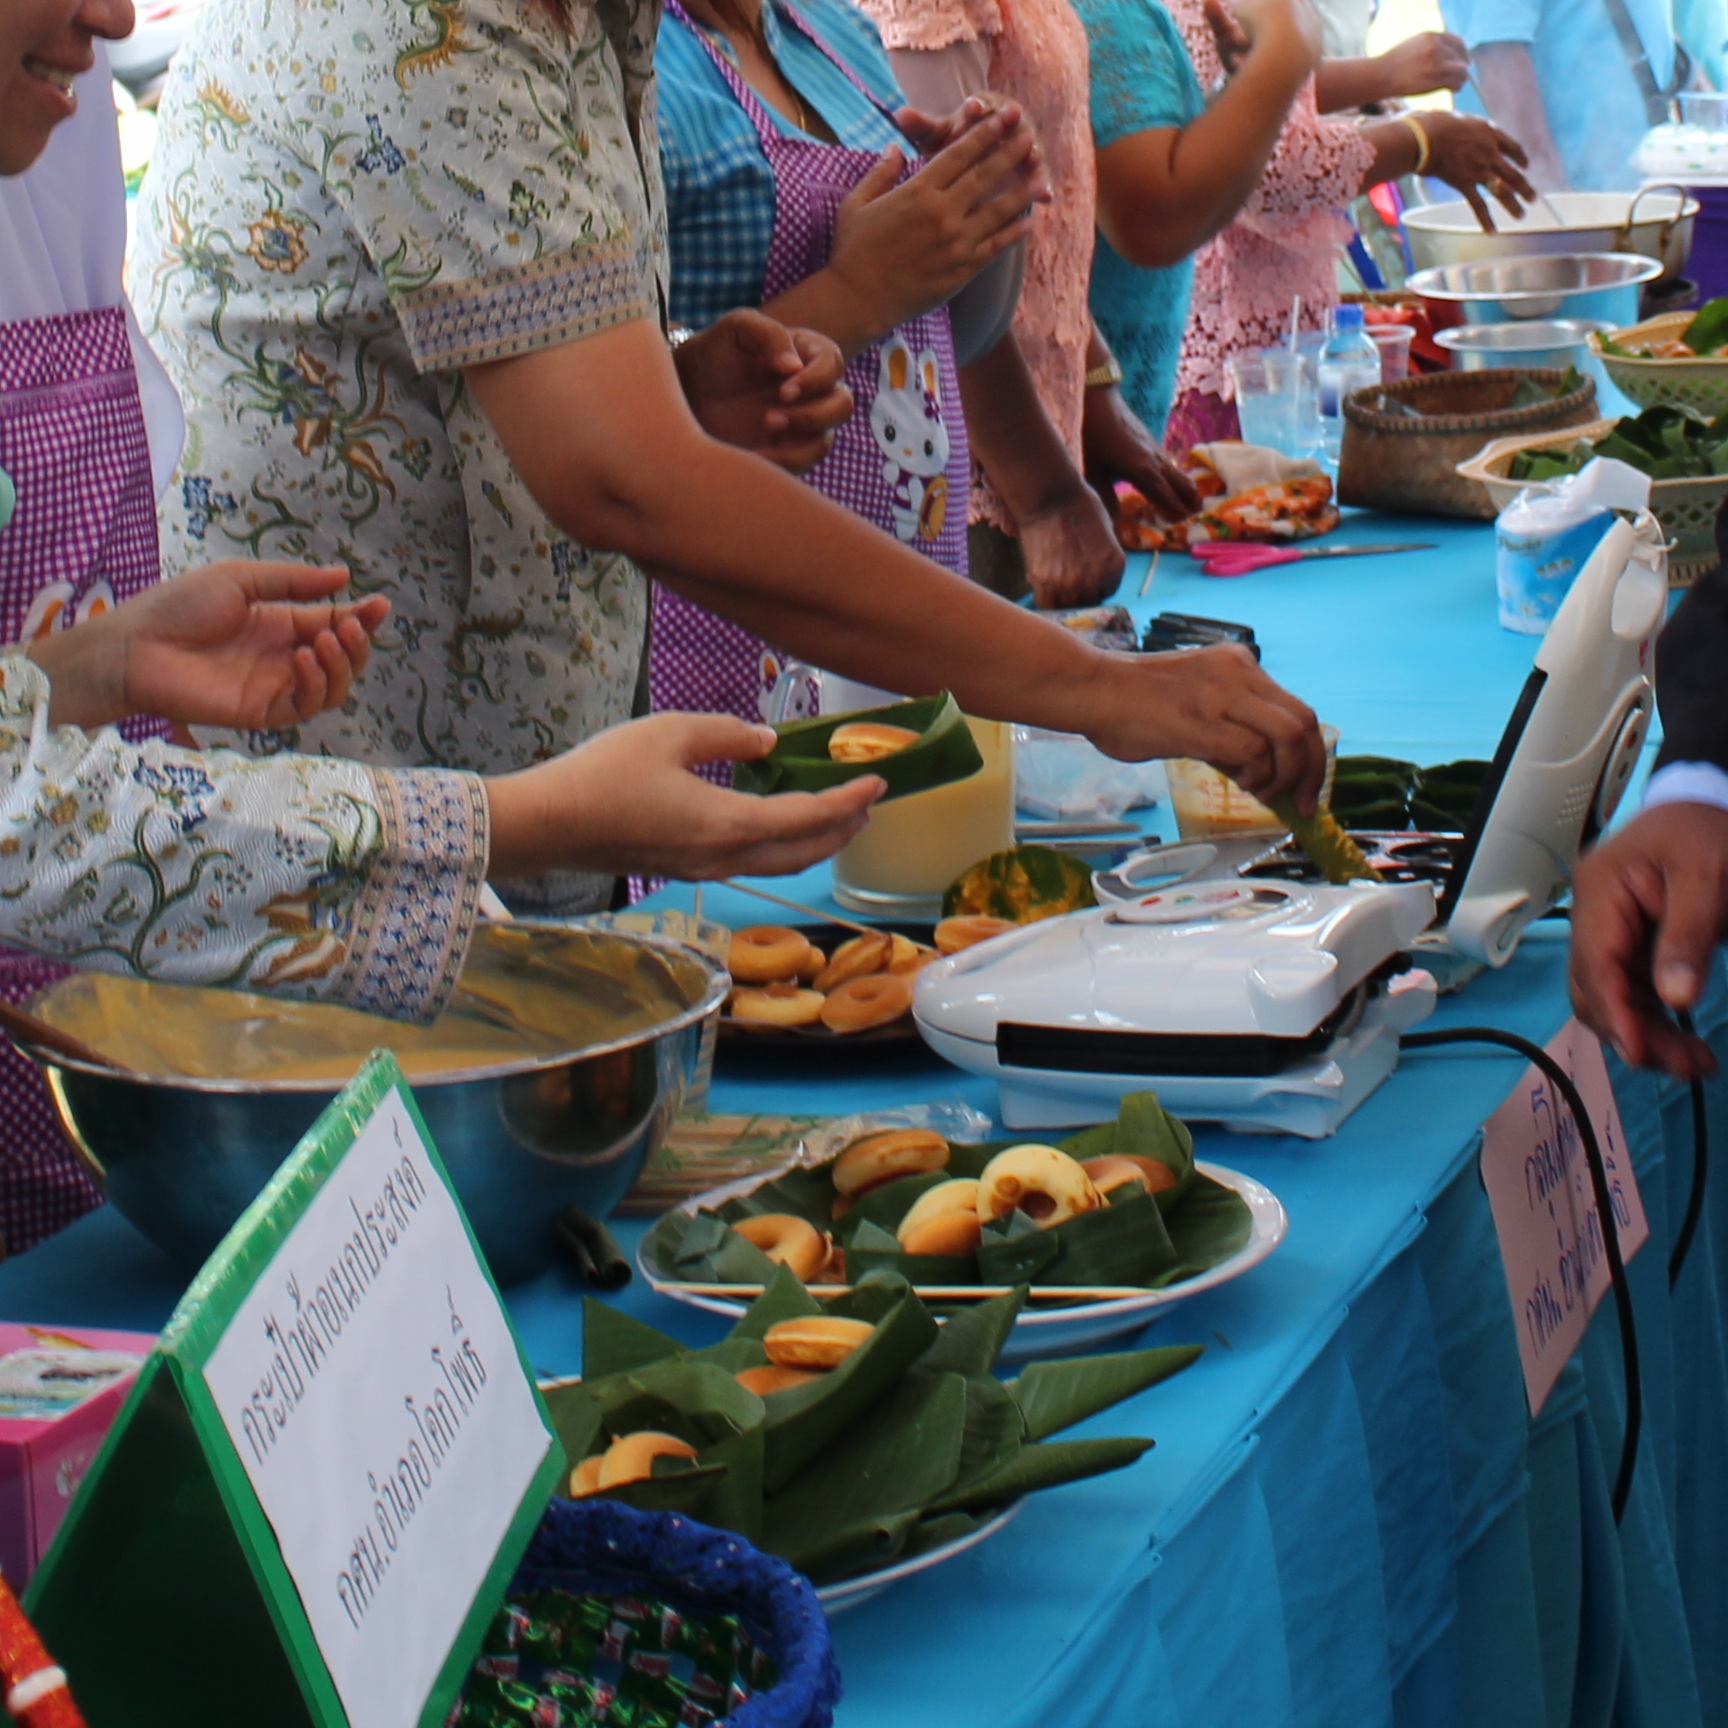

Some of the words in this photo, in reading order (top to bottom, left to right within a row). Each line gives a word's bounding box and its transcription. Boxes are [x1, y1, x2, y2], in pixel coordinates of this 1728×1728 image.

[240, 1116, 426, 1466] กระเป๋าผ้าอเนกประสงค์
